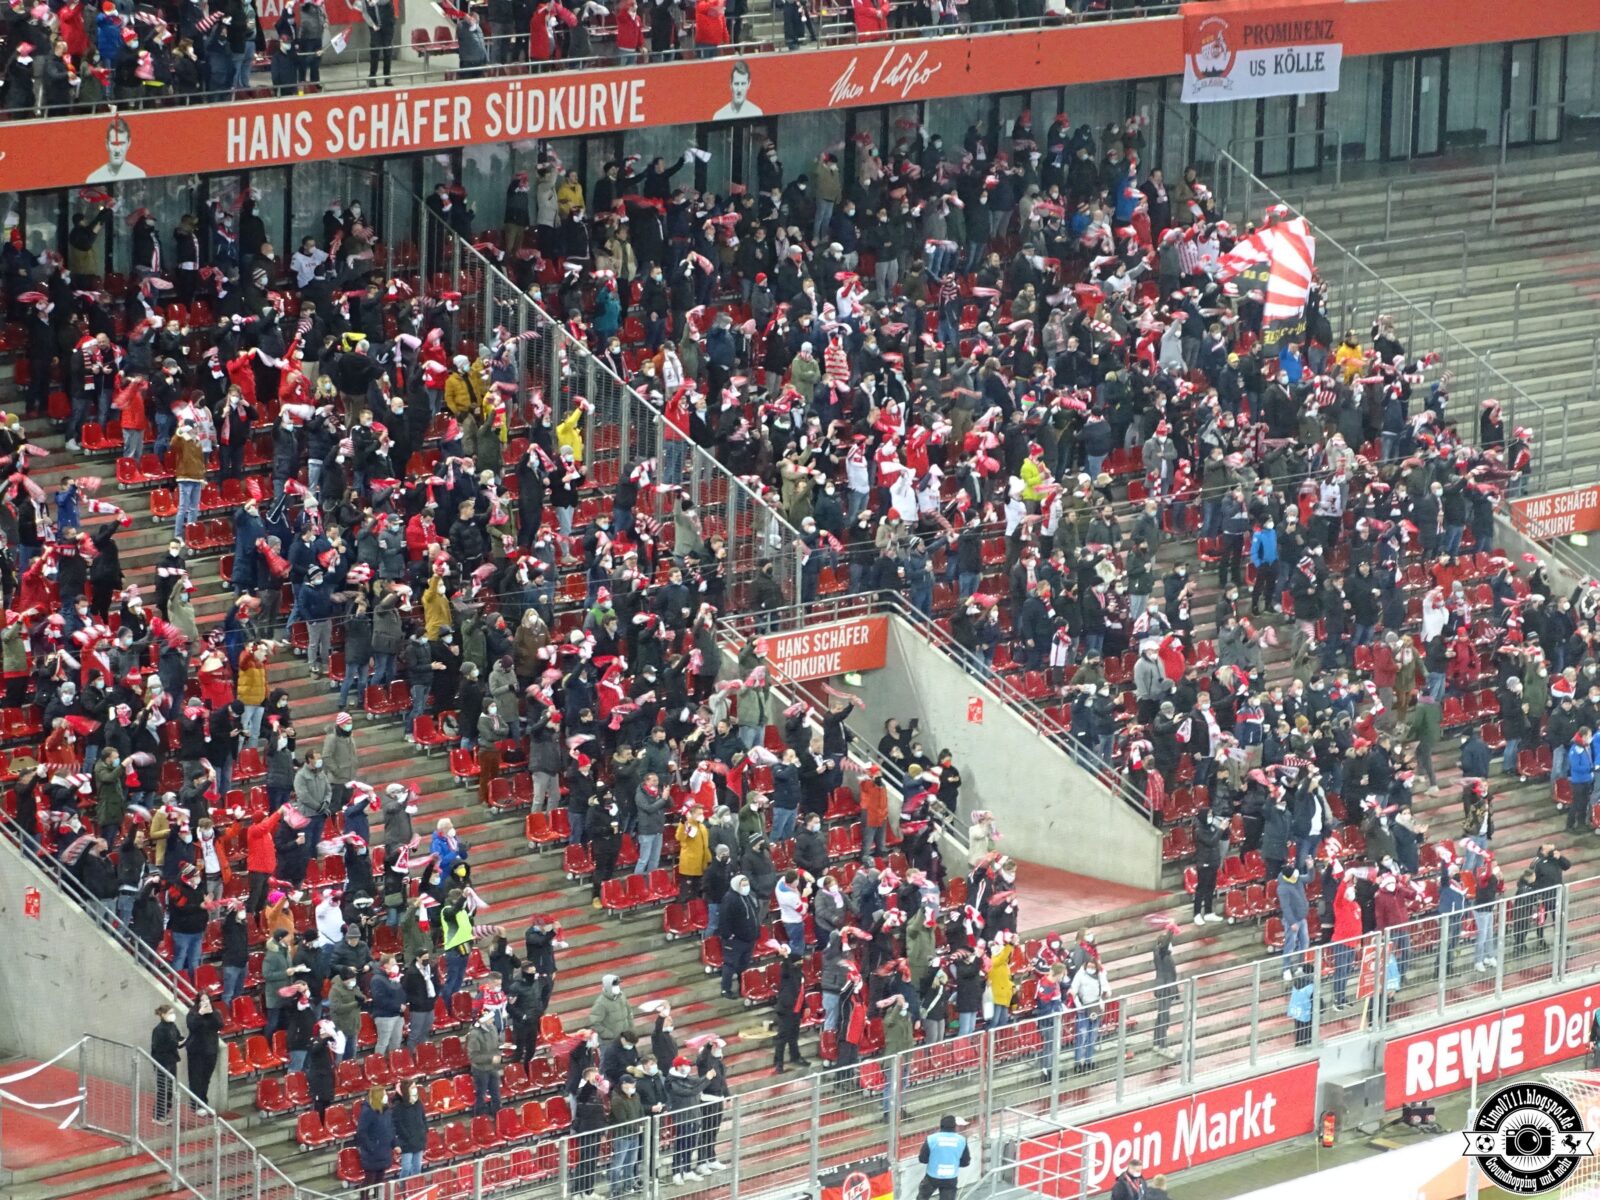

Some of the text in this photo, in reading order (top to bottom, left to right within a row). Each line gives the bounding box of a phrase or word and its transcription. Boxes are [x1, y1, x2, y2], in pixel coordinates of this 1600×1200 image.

[1243, 20, 1334, 45] PROMINENZ
[1249, 48, 1325, 77] US KÖLLE
[227, 79, 646, 163] HANS SCHÄFER SÜDKURVE
[1526, 490, 1598, 518] HANS SCHÄFER
[777, 625, 869, 659] HANS SCHÄFER
[775, 652, 841, 681] SÜDKURVE
[1405, 1013, 1525, 1096] REWE
[1087, 1089, 1277, 1186] Dein Markt
